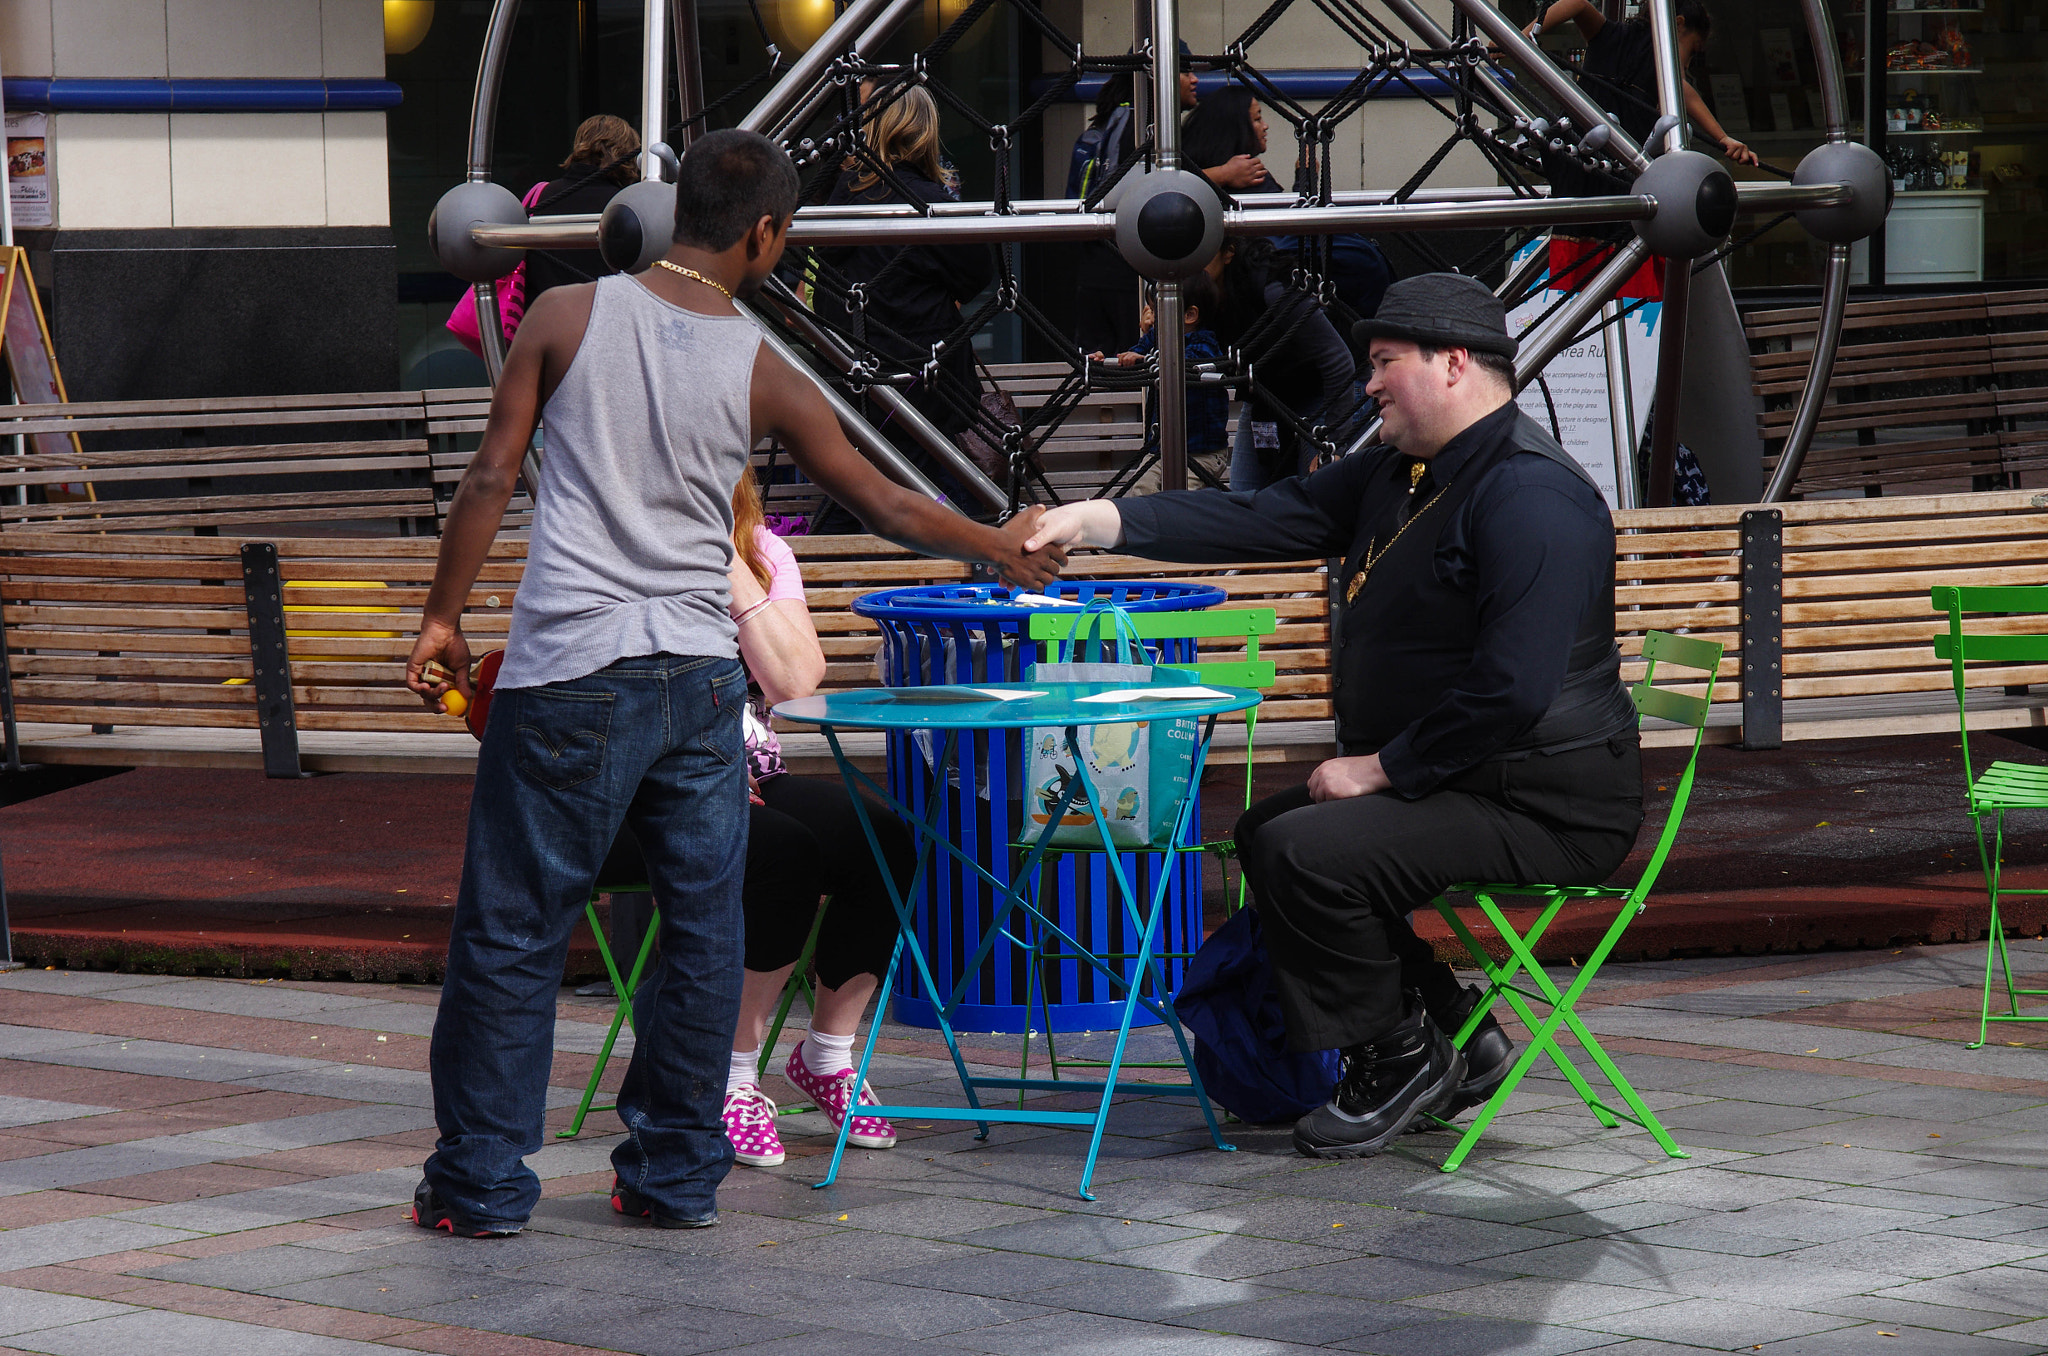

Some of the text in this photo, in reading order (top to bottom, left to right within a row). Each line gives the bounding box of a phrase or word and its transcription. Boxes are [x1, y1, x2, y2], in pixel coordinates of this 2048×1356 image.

[1588, 344, 1605, 358] Ru
[1552, 371, 1588, 379] accompanied
[1588, 371, 1596, 379] by
[1564, 386, 1571, 394] of
[1571, 386, 1580, 394] the
[1580, 386, 1593, 396] play
[1562, 401, 1572, 409] the
[1572, 401, 1585, 410] play
[1582, 416, 1608, 424] designed
[1176, 718, 1196, 730] BRITIS
[1167, 729, 1195, 741] COLUM
